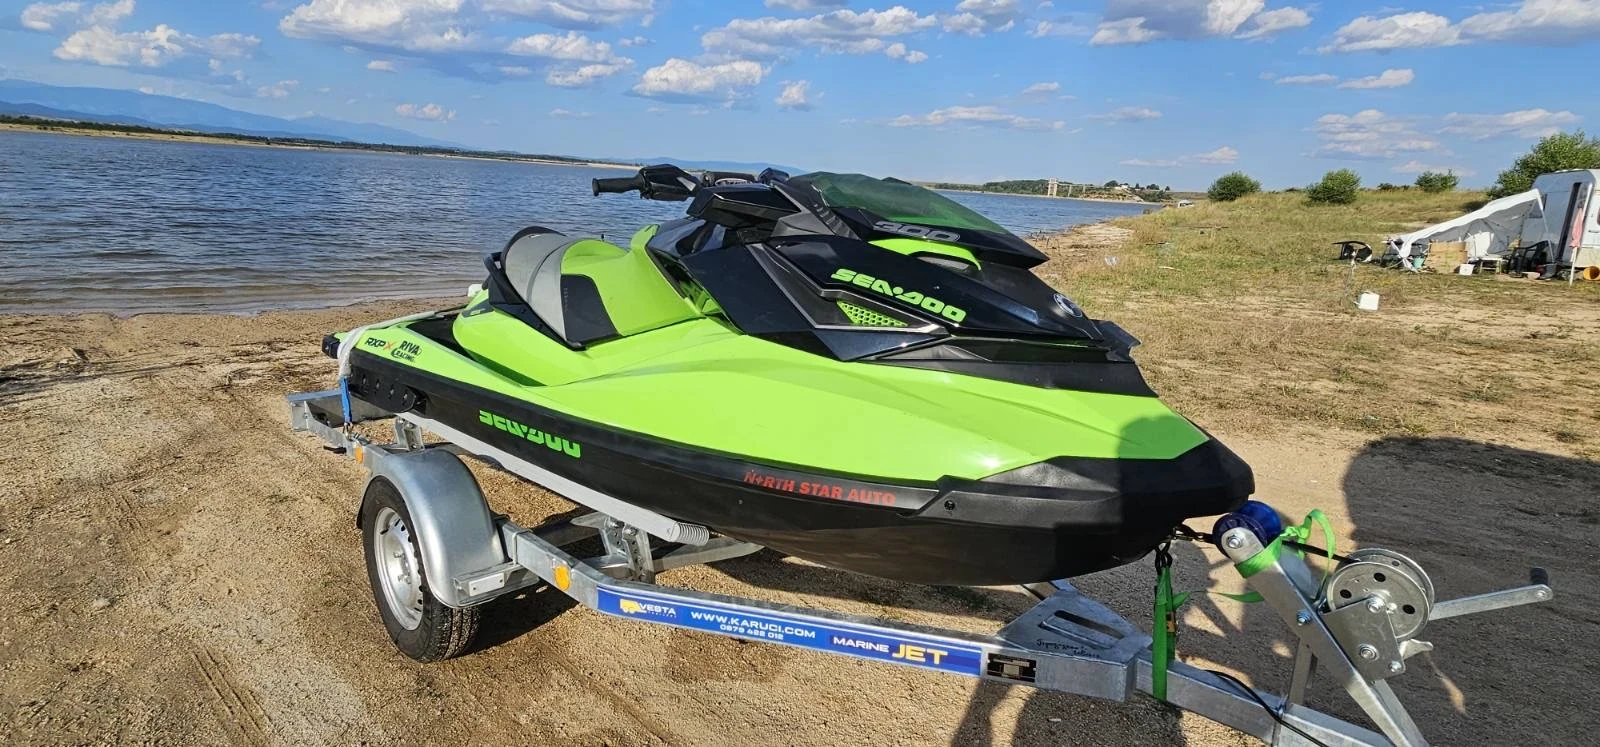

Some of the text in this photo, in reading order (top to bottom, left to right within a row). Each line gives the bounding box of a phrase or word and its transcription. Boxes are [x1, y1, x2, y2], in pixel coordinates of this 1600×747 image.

[872, 220, 960, 242] 300
[399, 340, 420, 355] RIVA
[799, 481, 843, 499] STAR
[848, 487, 896, 505] AUTO
[639, 603, 677, 615] VESTA
[690, 611, 816, 639] WWW.KARUCI.COM
[833, 636, 948, 665] MARINE JET
